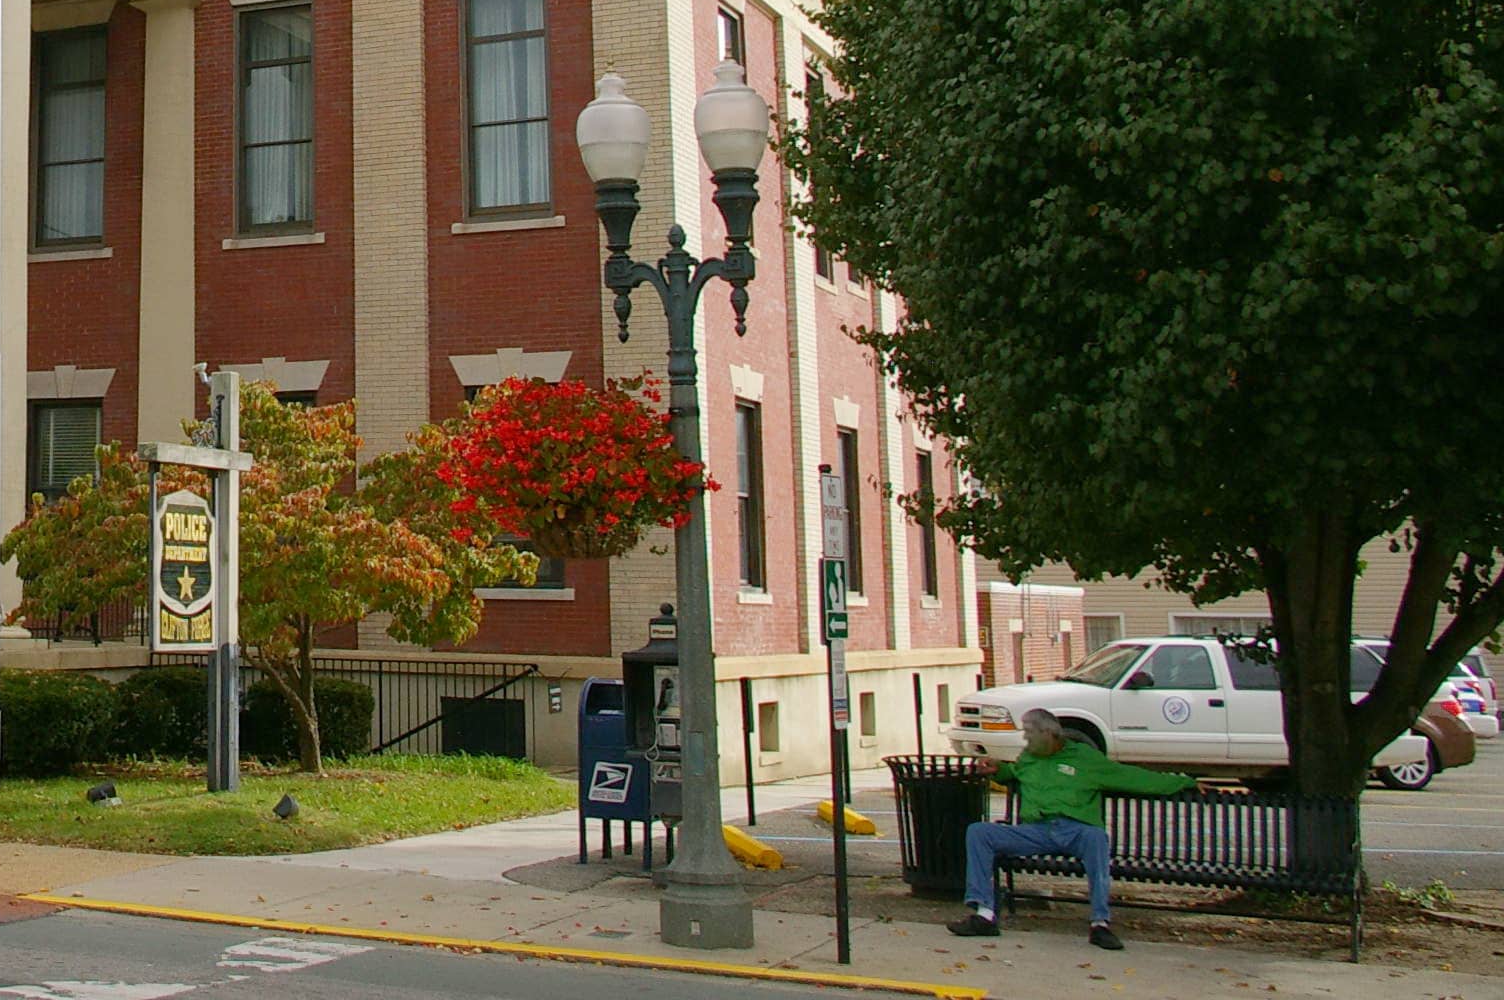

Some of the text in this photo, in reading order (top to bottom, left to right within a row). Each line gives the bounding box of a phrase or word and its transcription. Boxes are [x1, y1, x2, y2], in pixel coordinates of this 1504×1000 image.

[165, 513, 207, 541] POLICE
[165, 545, 207, 561] DEPARTMENT
[161, 609, 188, 640] CLIFTON
